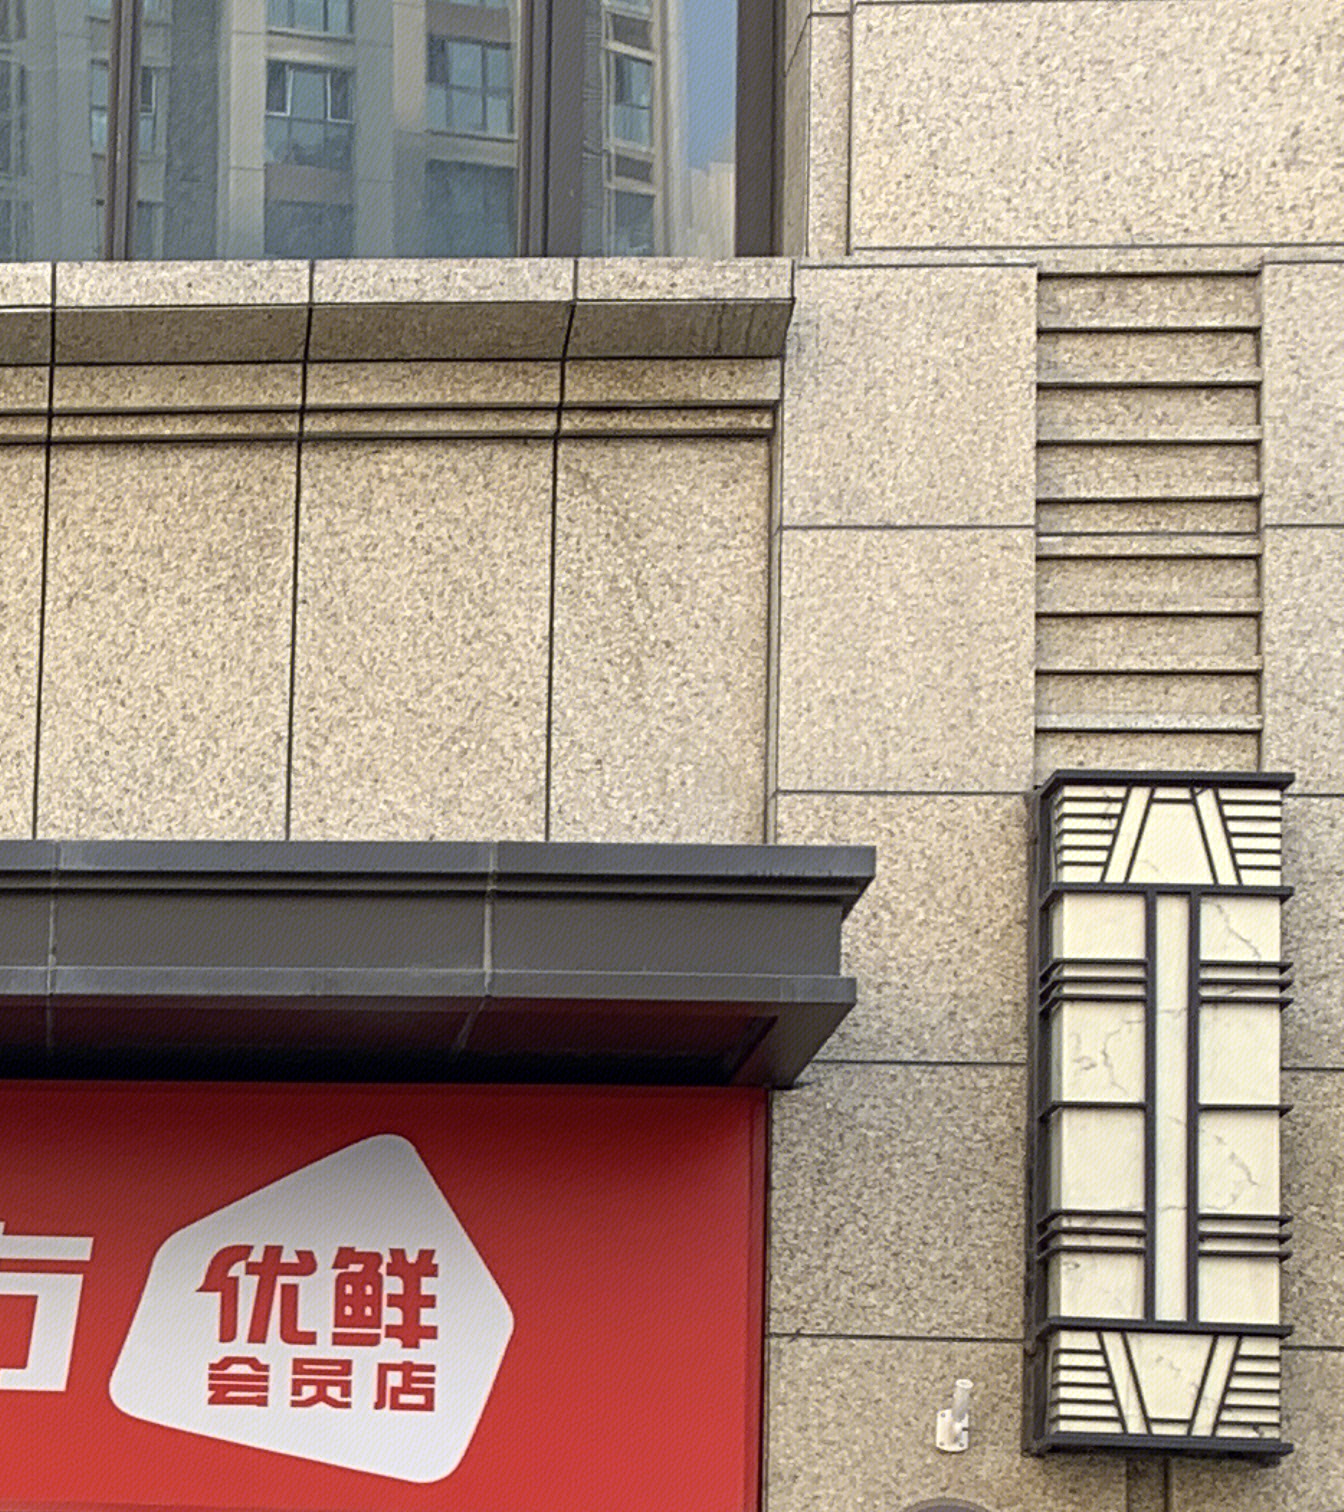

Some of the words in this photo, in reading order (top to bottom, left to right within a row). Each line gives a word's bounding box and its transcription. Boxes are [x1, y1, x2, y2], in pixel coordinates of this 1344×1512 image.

[195, 1243, 440, 1350] 优鲜
[206, 1355, 438, 1412] 会员店
